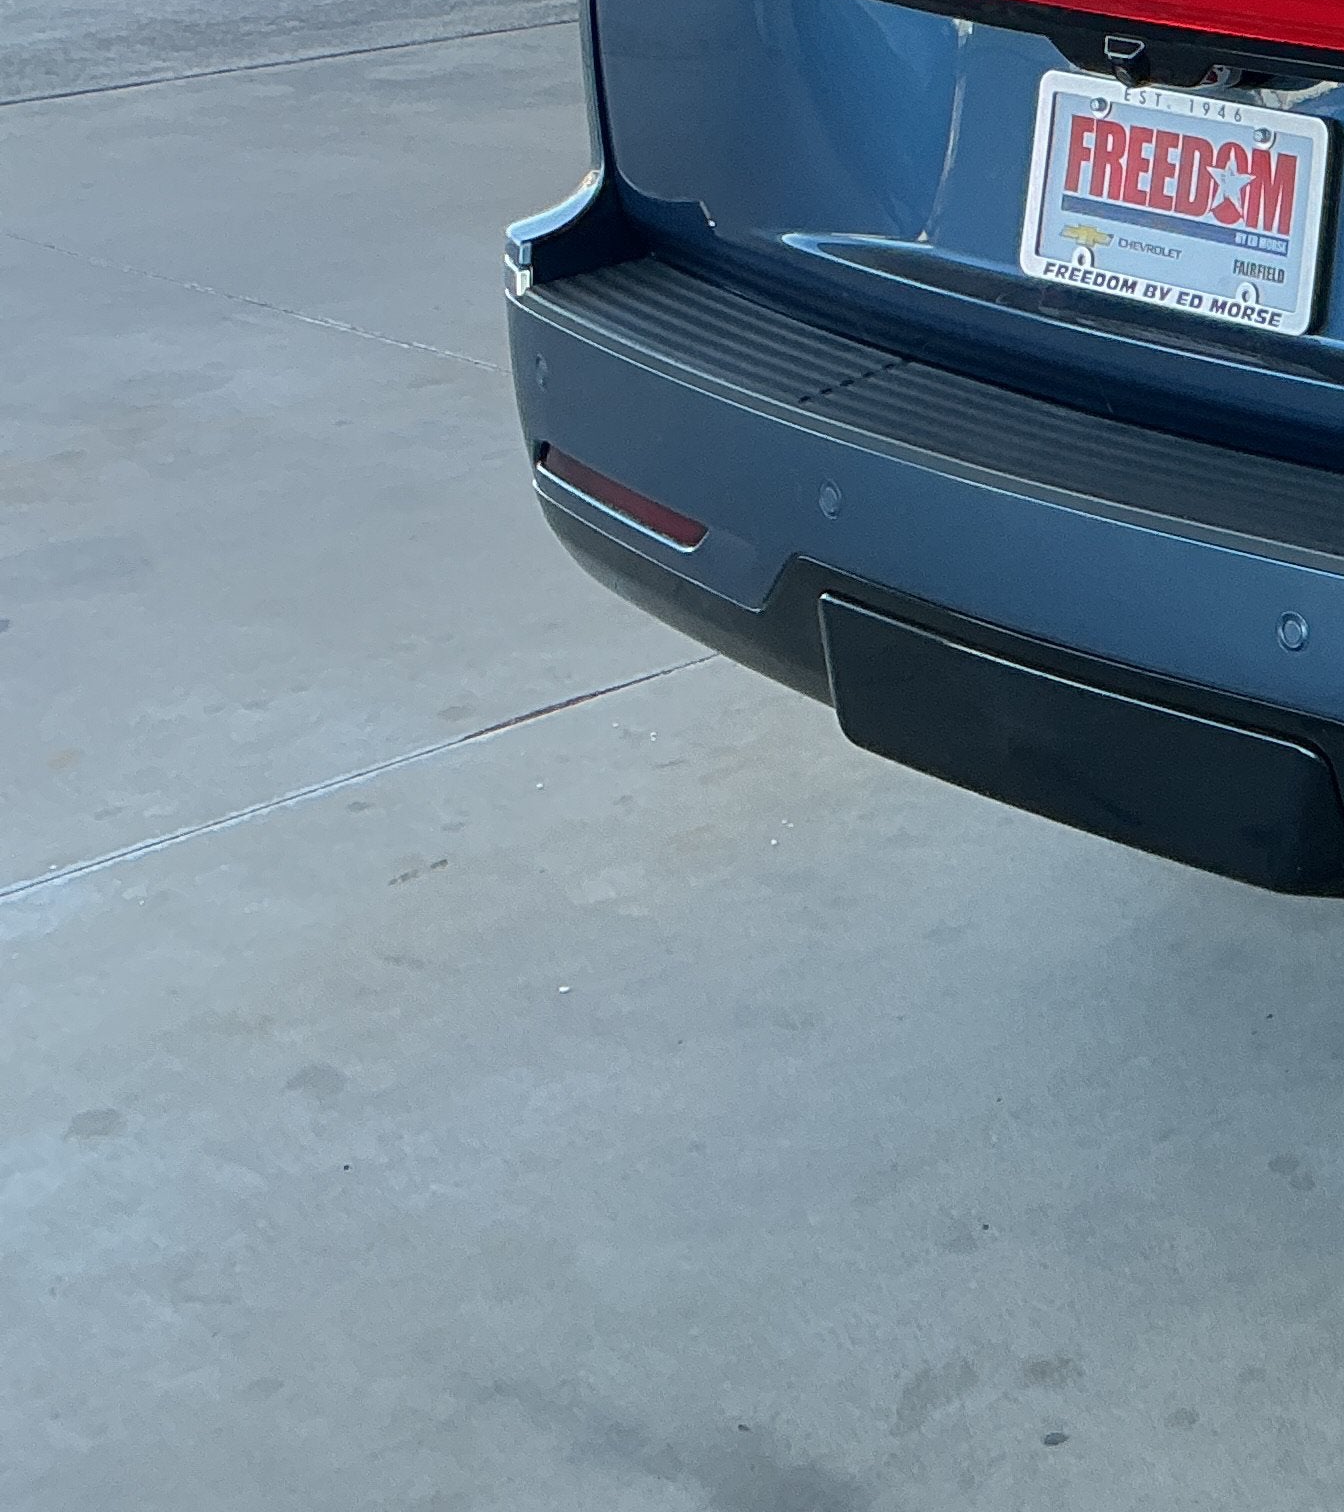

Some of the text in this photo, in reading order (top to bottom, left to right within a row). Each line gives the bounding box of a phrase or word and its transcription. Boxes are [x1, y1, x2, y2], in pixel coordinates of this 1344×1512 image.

[1123, 88, 1242, 123] EST. 1946
[1064, 114, 1298, 237] FREEDOM
[1118, 238, 1182, 260] CHEVROLET
[1232, 258, 1286, 284] FAIRFIELD
[1042, 261, 1283, 328] FREEDOM BY ED MORSE
